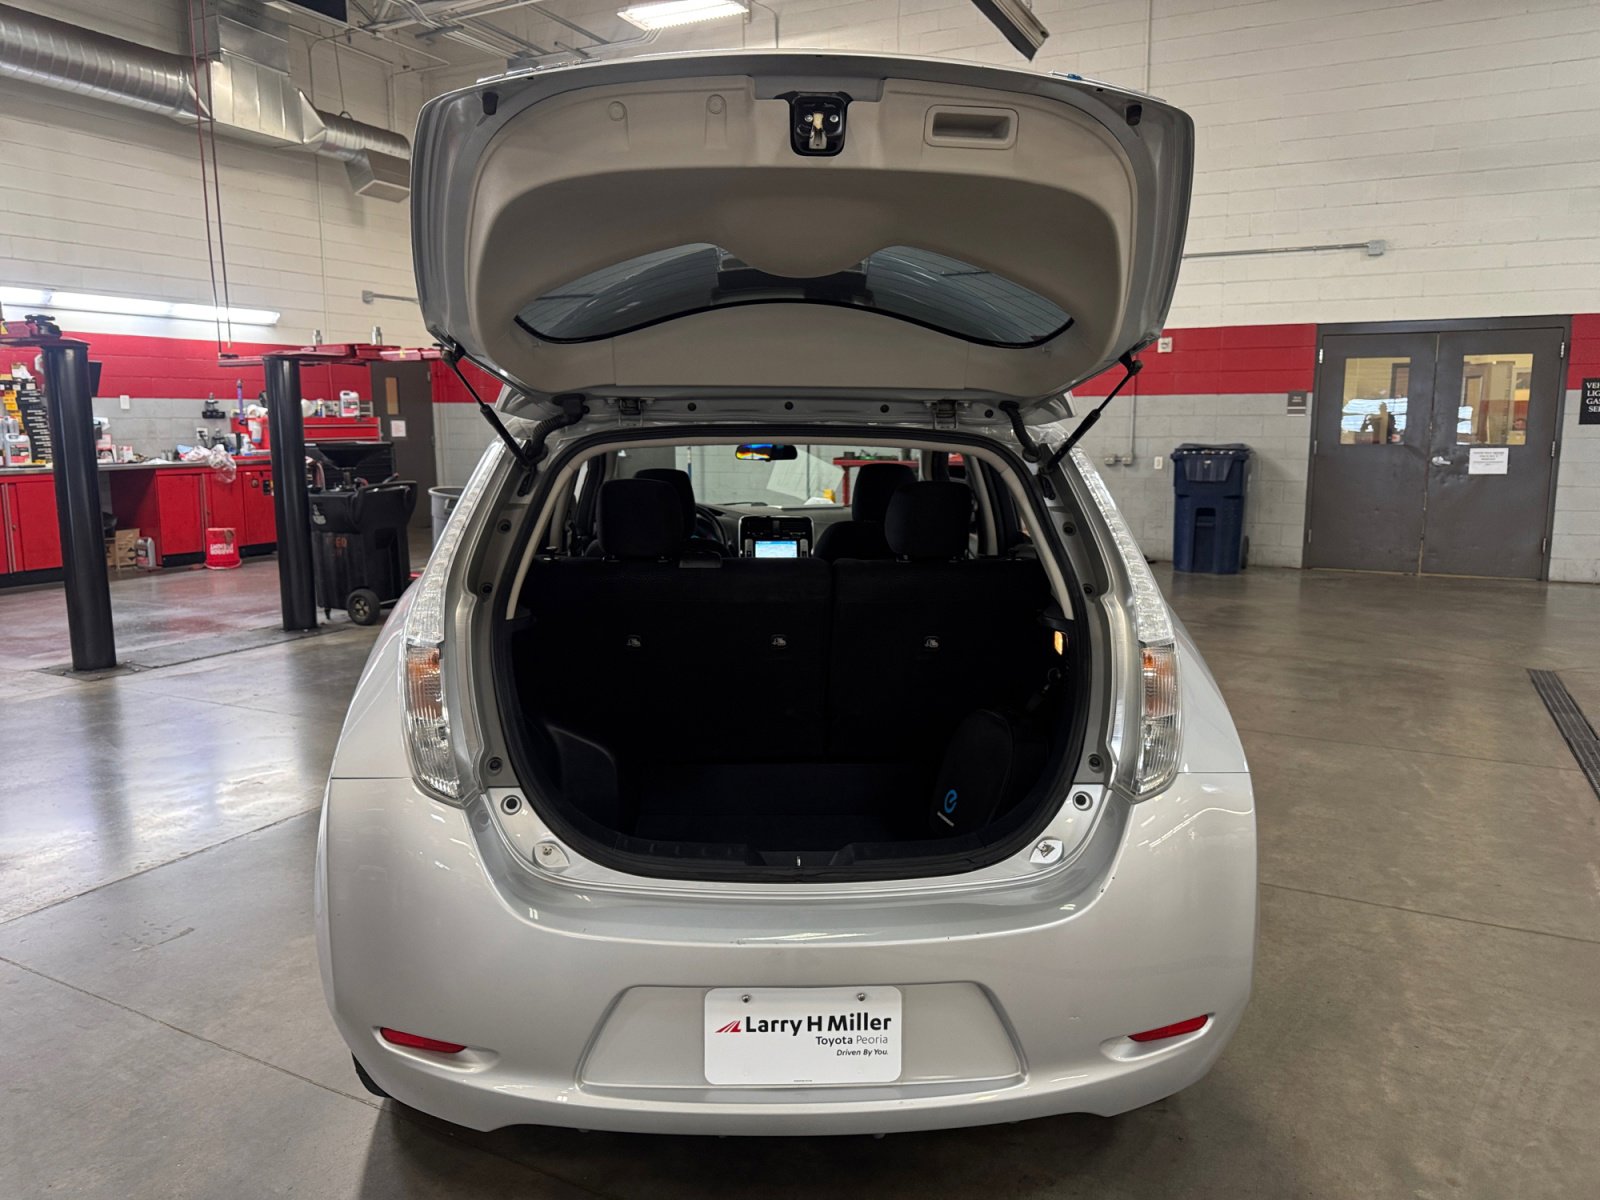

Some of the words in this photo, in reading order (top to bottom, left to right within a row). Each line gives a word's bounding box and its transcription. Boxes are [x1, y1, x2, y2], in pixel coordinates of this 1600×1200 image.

[745, 1016, 803, 1036] Larry
[807, 1015, 822, 1031] H
[827, 1012, 892, 1031] Miller
[815, 1036, 853, 1046] Toyota
[856, 1034, 888, 1045] Peoria
[836, 1049, 861, 1057] Driven
[863, 1049, 873, 1057] By
